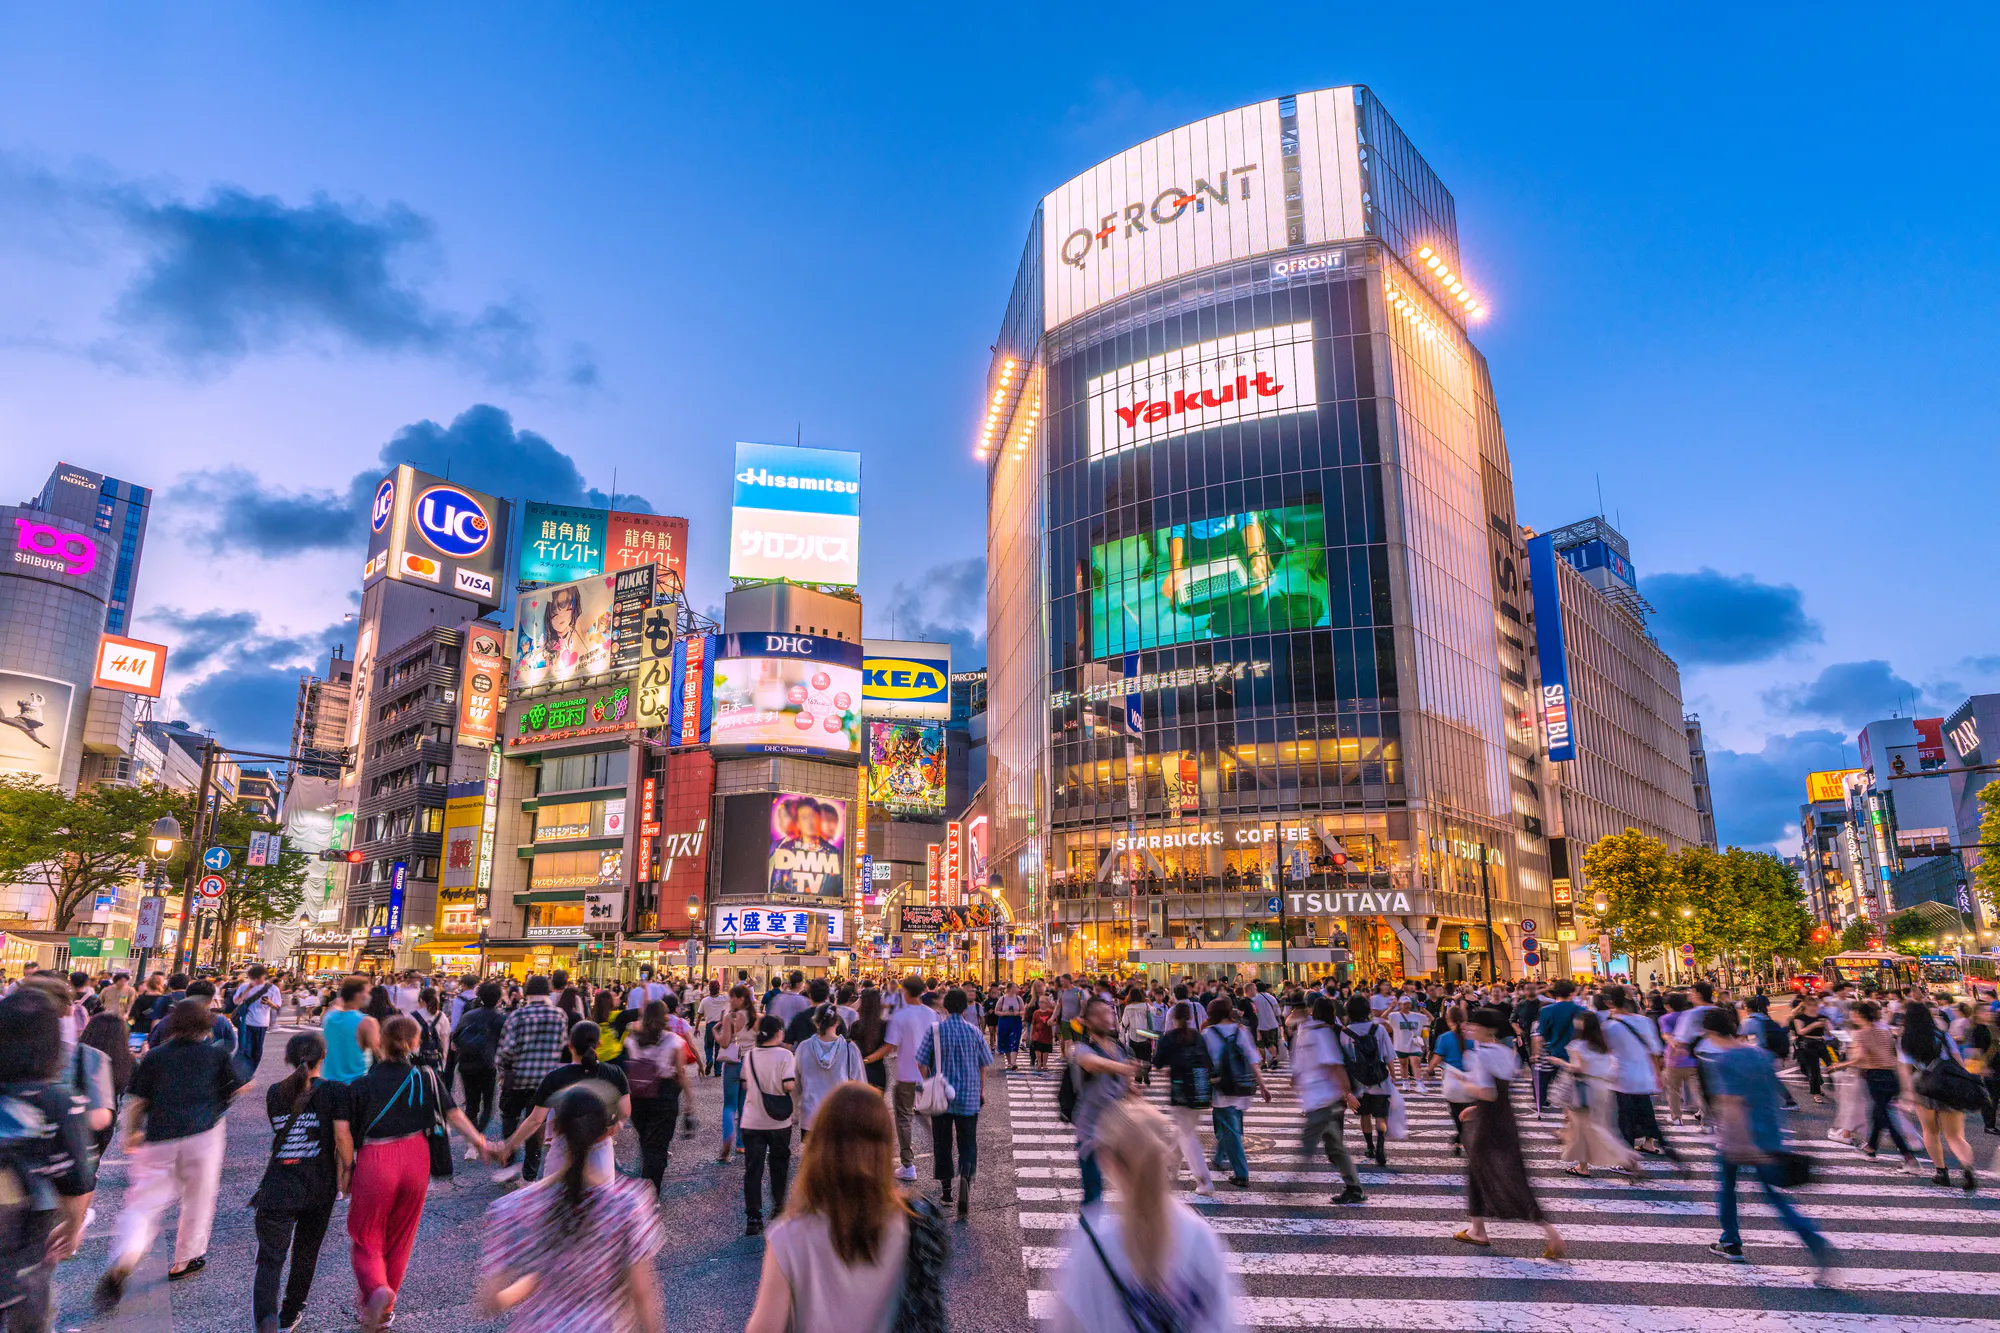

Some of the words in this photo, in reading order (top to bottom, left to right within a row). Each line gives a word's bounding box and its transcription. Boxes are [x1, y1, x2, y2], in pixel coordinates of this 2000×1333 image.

[1061, 163, 1257, 271] QFRONT
[1274, 253, 1341, 277] QFRONT
[1126, 351, 1266, 398] 人も地球も健康に
[1114, 371, 1284, 428] Yakult
[60, 474, 96, 490] INDIGO
[69, 471, 89, 482] HOTEL
[736, 468, 858, 494] Hisamitsu
[423, 497, 487, 544] UC
[541, 521, 591, 542] 龍角散
[15, 518, 96, 575] 109
[533, 540, 599, 563] ダイレクト
[625, 529, 672, 550] 龍角散
[739, 529, 850, 563] サロンパス
[14, 552, 65, 573] SHIBUYA
[458, 573, 491, 592] VISA
[617, 569, 649, 591] NIKKE
[766, 635, 813, 654] DHC
[110, 654, 147, 676] H&M
[640, 608, 673, 722] もんじゃ
[863, 669, 938, 689] KEA
[951, 673, 977, 682] PARCO
[681, 643, 700, 737] 三千里薬品
[547, 706, 586, 729] 西村
[1544, 683, 1569, 750] SEIBU
[1949, 716, 1980, 757] ZAR
[781, 746, 808, 754] Channel
[666, 832, 704, 858] クスリ
[949, 829, 958, 873] カラオケ
[1116, 830, 1224, 852] STARBUCKS
[1236, 827, 1310, 844] COFFEE
[1844, 821, 1859, 862] KARAOKE
[775, 848, 840, 874] DMM
[792, 872, 824, 894] TV
[1289, 893, 1410, 912] TSUTAYA
[1958, 885, 1971, 913] ZARA
[138, 901, 152, 942] 道玄坂
[303, 930, 350, 943] グルメタウン
